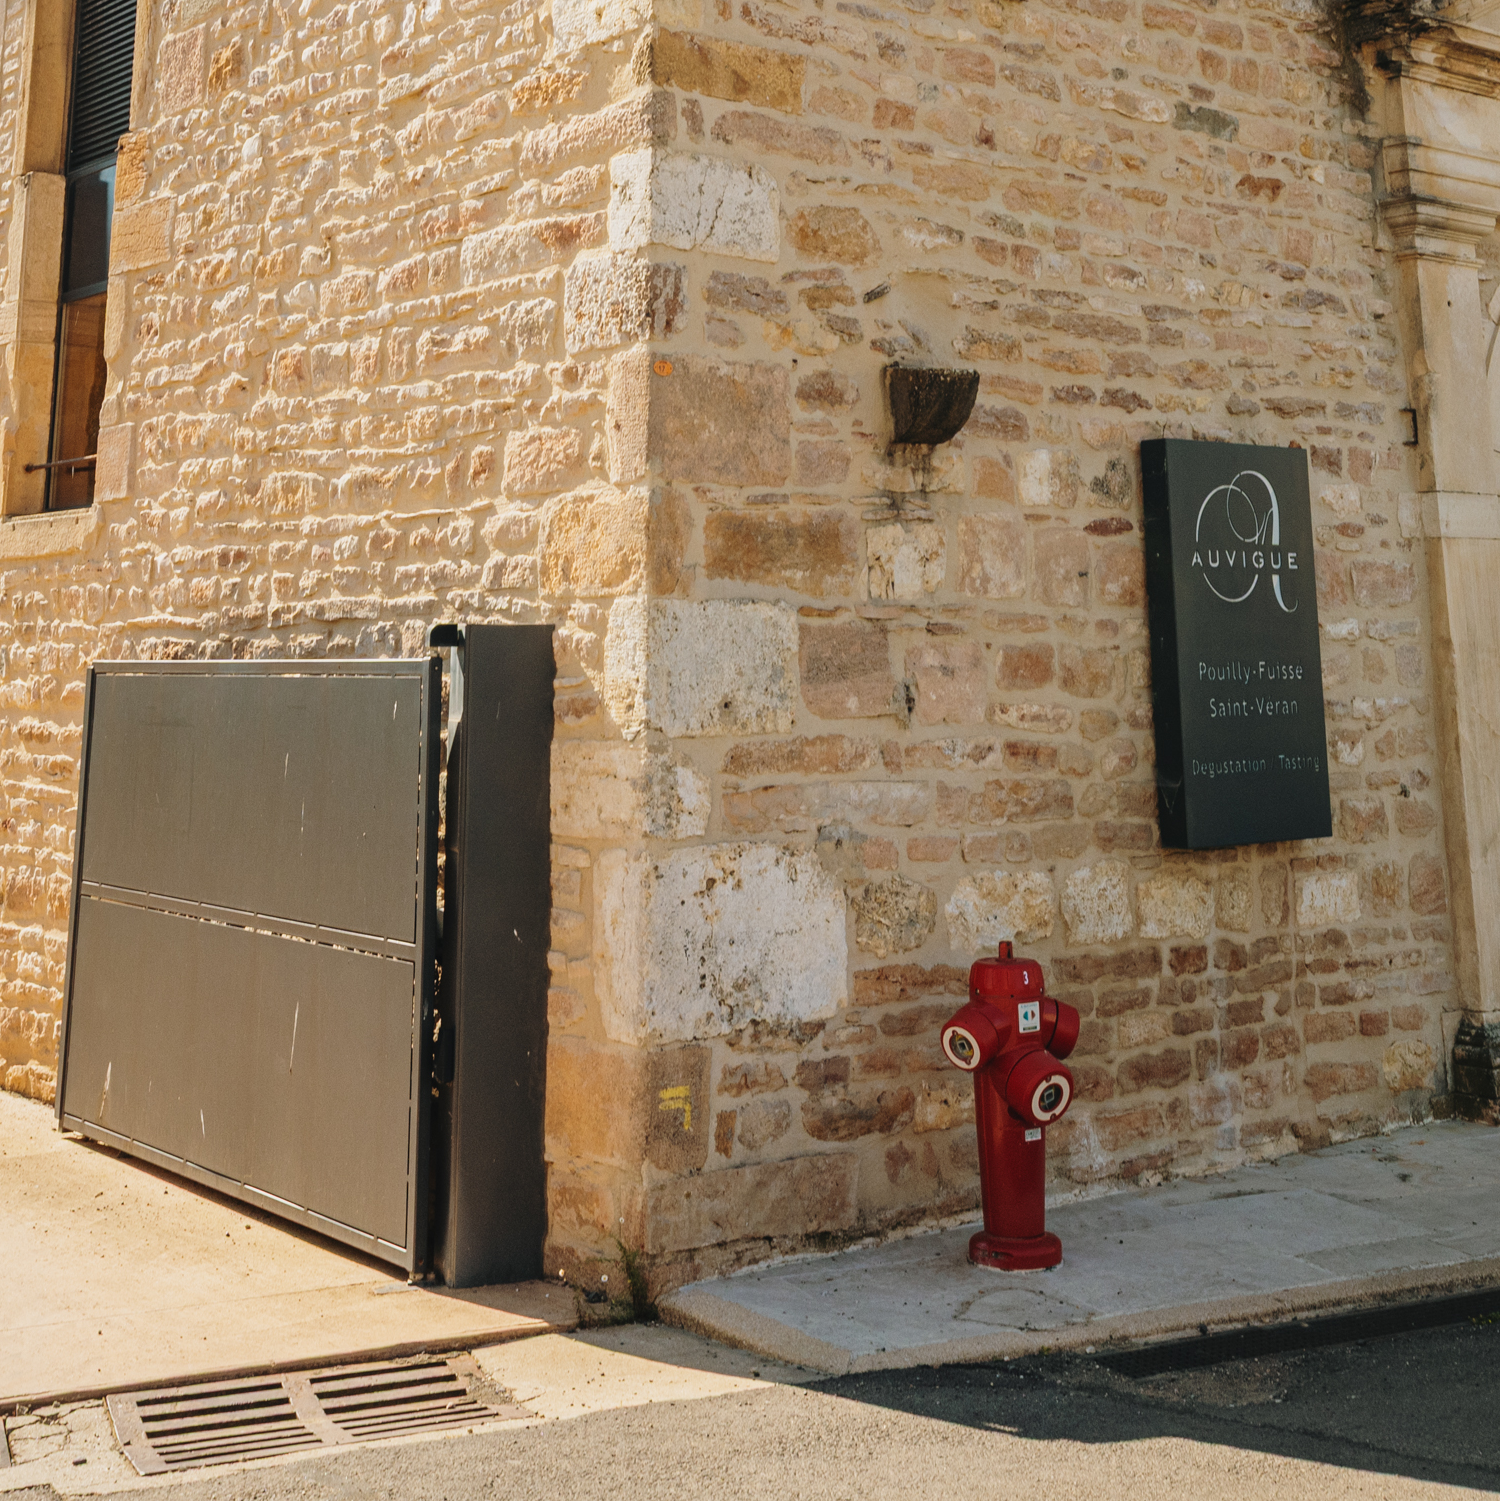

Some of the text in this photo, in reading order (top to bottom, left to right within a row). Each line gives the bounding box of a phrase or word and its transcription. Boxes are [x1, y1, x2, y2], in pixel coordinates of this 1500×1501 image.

[1191, 550, 1299, 570] AUVIGUE
[1198, 658, 1304, 685] Pouilly-Fuissé
[1209, 695, 1299, 718] Saint-Véran
[1278, 754, 1321, 773] Tasting
[1023, 970, 1030, 986] 3
